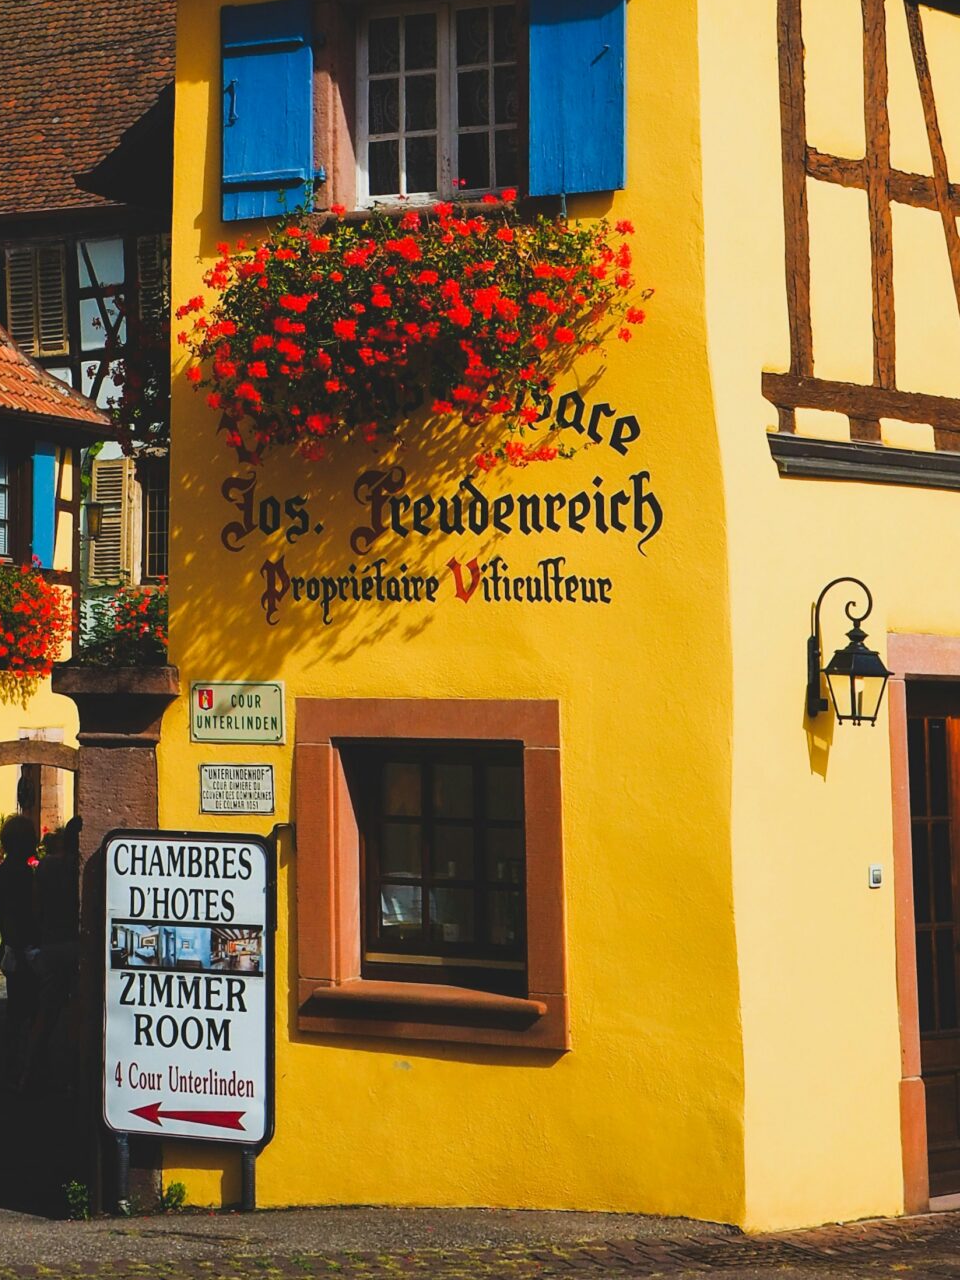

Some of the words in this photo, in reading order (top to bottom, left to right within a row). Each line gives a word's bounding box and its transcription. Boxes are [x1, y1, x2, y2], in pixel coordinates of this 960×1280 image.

[490, 384, 641, 457] sace
[220, 470, 324, 553] Jos.
[349, 466, 664, 557] Freudenreich
[260, 555, 440, 626] Propriétaire
[446, 556, 613, 605] Viticulteur
[230, 694, 262, 709] COUR
[196, 715, 278, 731] UNTERLINDEN
[208, 768, 265, 780] UNTERLINDENHOF
[113, 843, 253, 881] CHAMBRES
[129, 886, 236, 923] D'HOTES
[119, 972, 248, 1013] ZIMMER
[134, 1013, 232, 1052] ROOM
[114, 1060, 123, 1088] 4
[127, 1062, 163, 1092] Cour
[168, 1065, 255, 1099] Unterlinden
